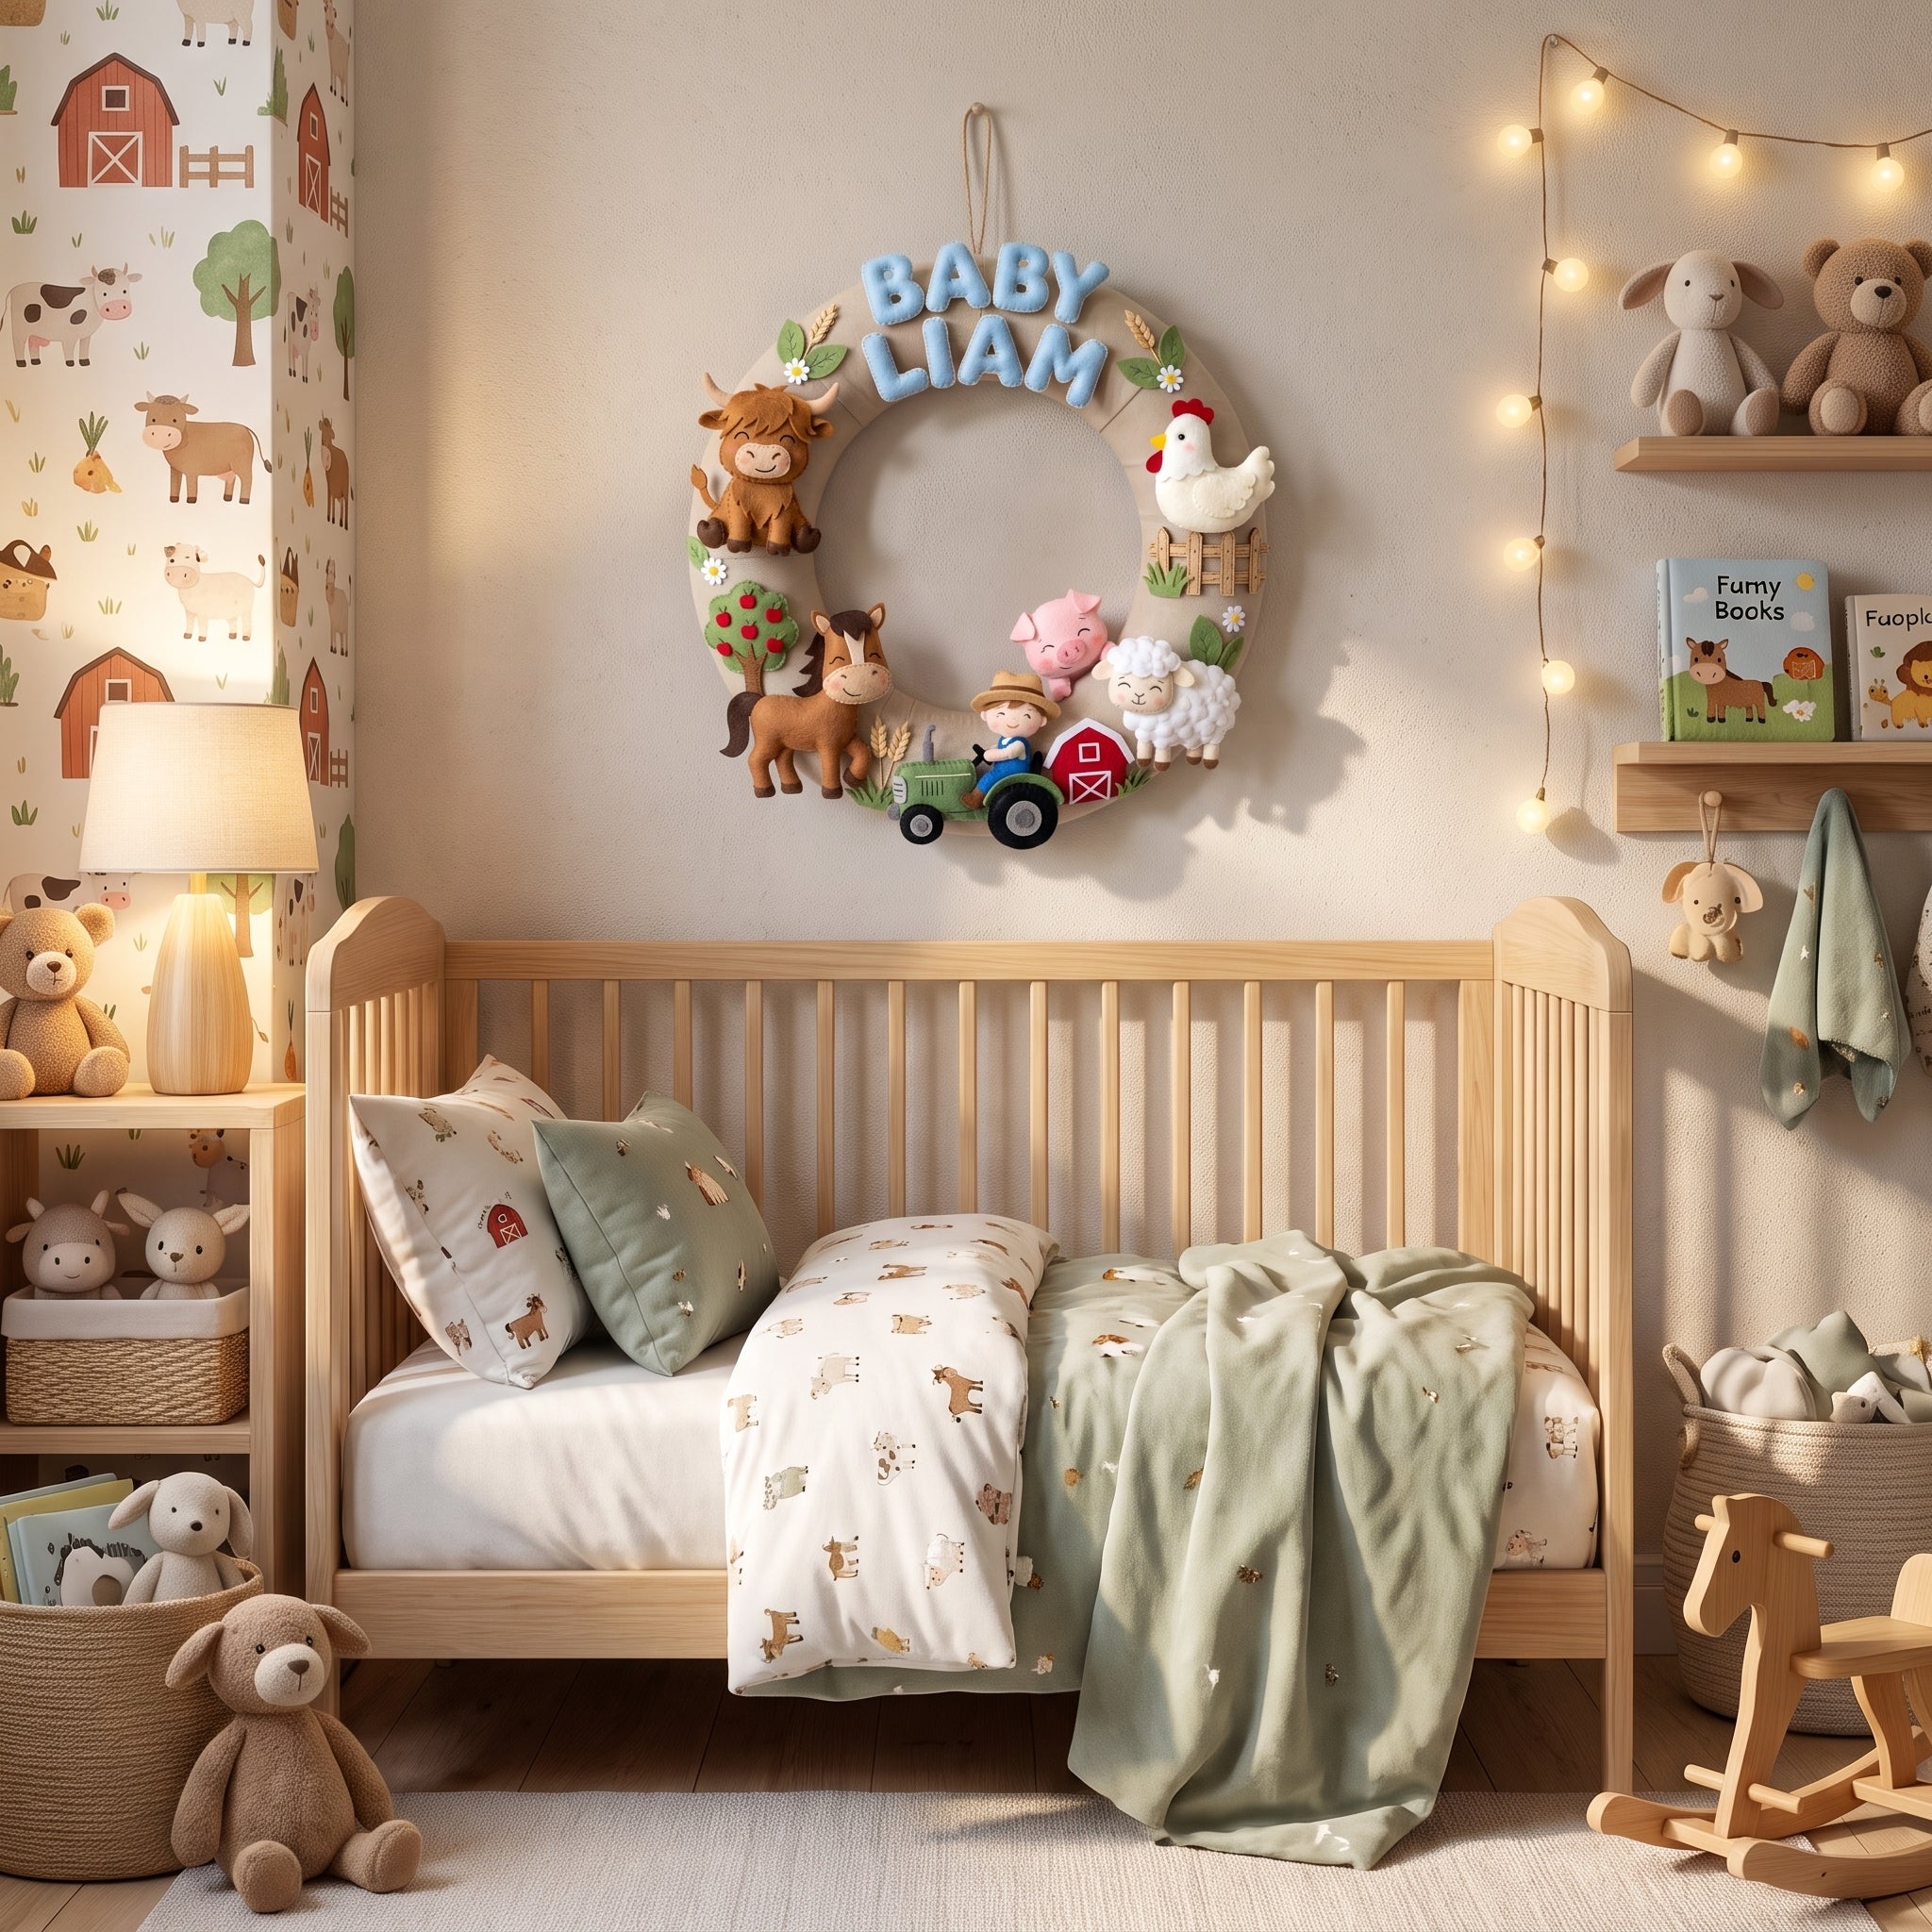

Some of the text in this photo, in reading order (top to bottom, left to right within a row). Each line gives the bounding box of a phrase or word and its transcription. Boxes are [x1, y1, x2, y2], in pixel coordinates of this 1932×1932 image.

[861, 242, 1110, 325] BABY
[861, 314, 1108, 408] LIAM
[1716, 600, 1785, 621] Books
